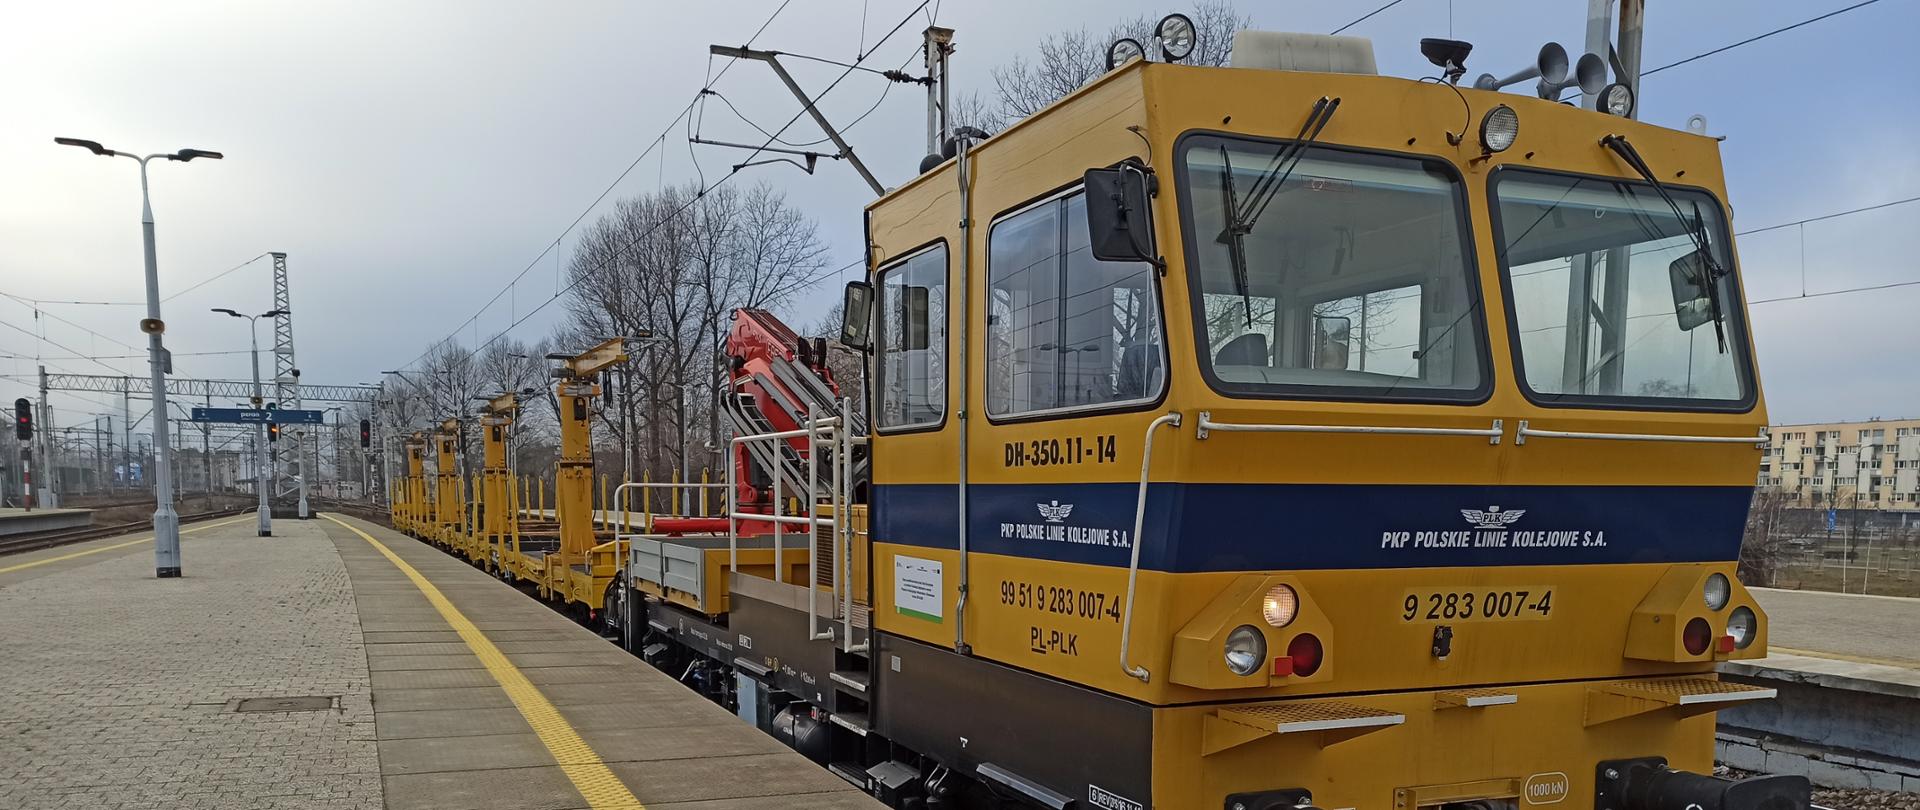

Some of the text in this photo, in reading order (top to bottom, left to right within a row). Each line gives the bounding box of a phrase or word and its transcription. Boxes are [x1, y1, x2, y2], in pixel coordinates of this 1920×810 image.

[265, 412, 273, 420] 2
[1482, 514, 1502, 524] PLK
[1000, 523, 1131, 548] PKP POLSKIE LINIE KOLEJOWE S.A.
[1381, 530, 1608, 549] PKP POLSKIE LINIE KOLEJOWE S.A.
[1001, 580, 1121, 624] 99 51 9 283 007-4
[1402, 590, 1552, 621] 9 283 007-4
[1031, 627, 1077, 657] PL-PLK
[1092, 790, 1097, 801] 6
[1530, 782, 1563, 796] 1000 kN
